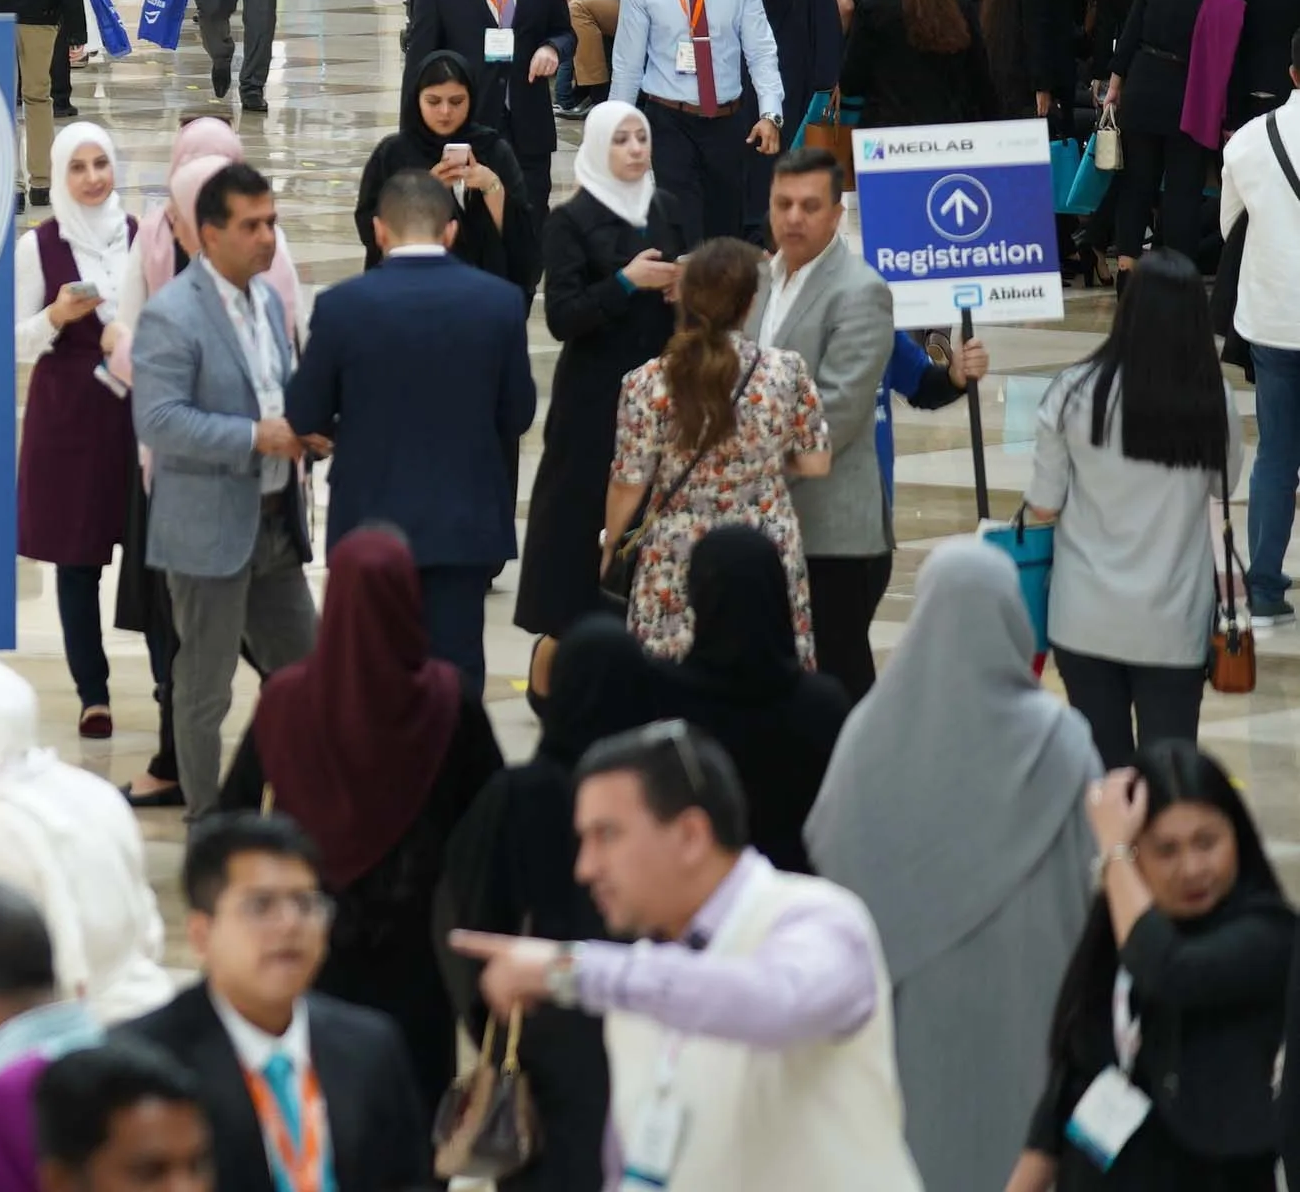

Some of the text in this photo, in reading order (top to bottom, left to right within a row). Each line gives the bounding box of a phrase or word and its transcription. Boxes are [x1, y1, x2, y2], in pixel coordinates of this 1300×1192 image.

[888, 139, 974, 155] MEDLAB
[877, 240, 1043, 277] Registration
[989, 285, 1045, 301] Abbott
